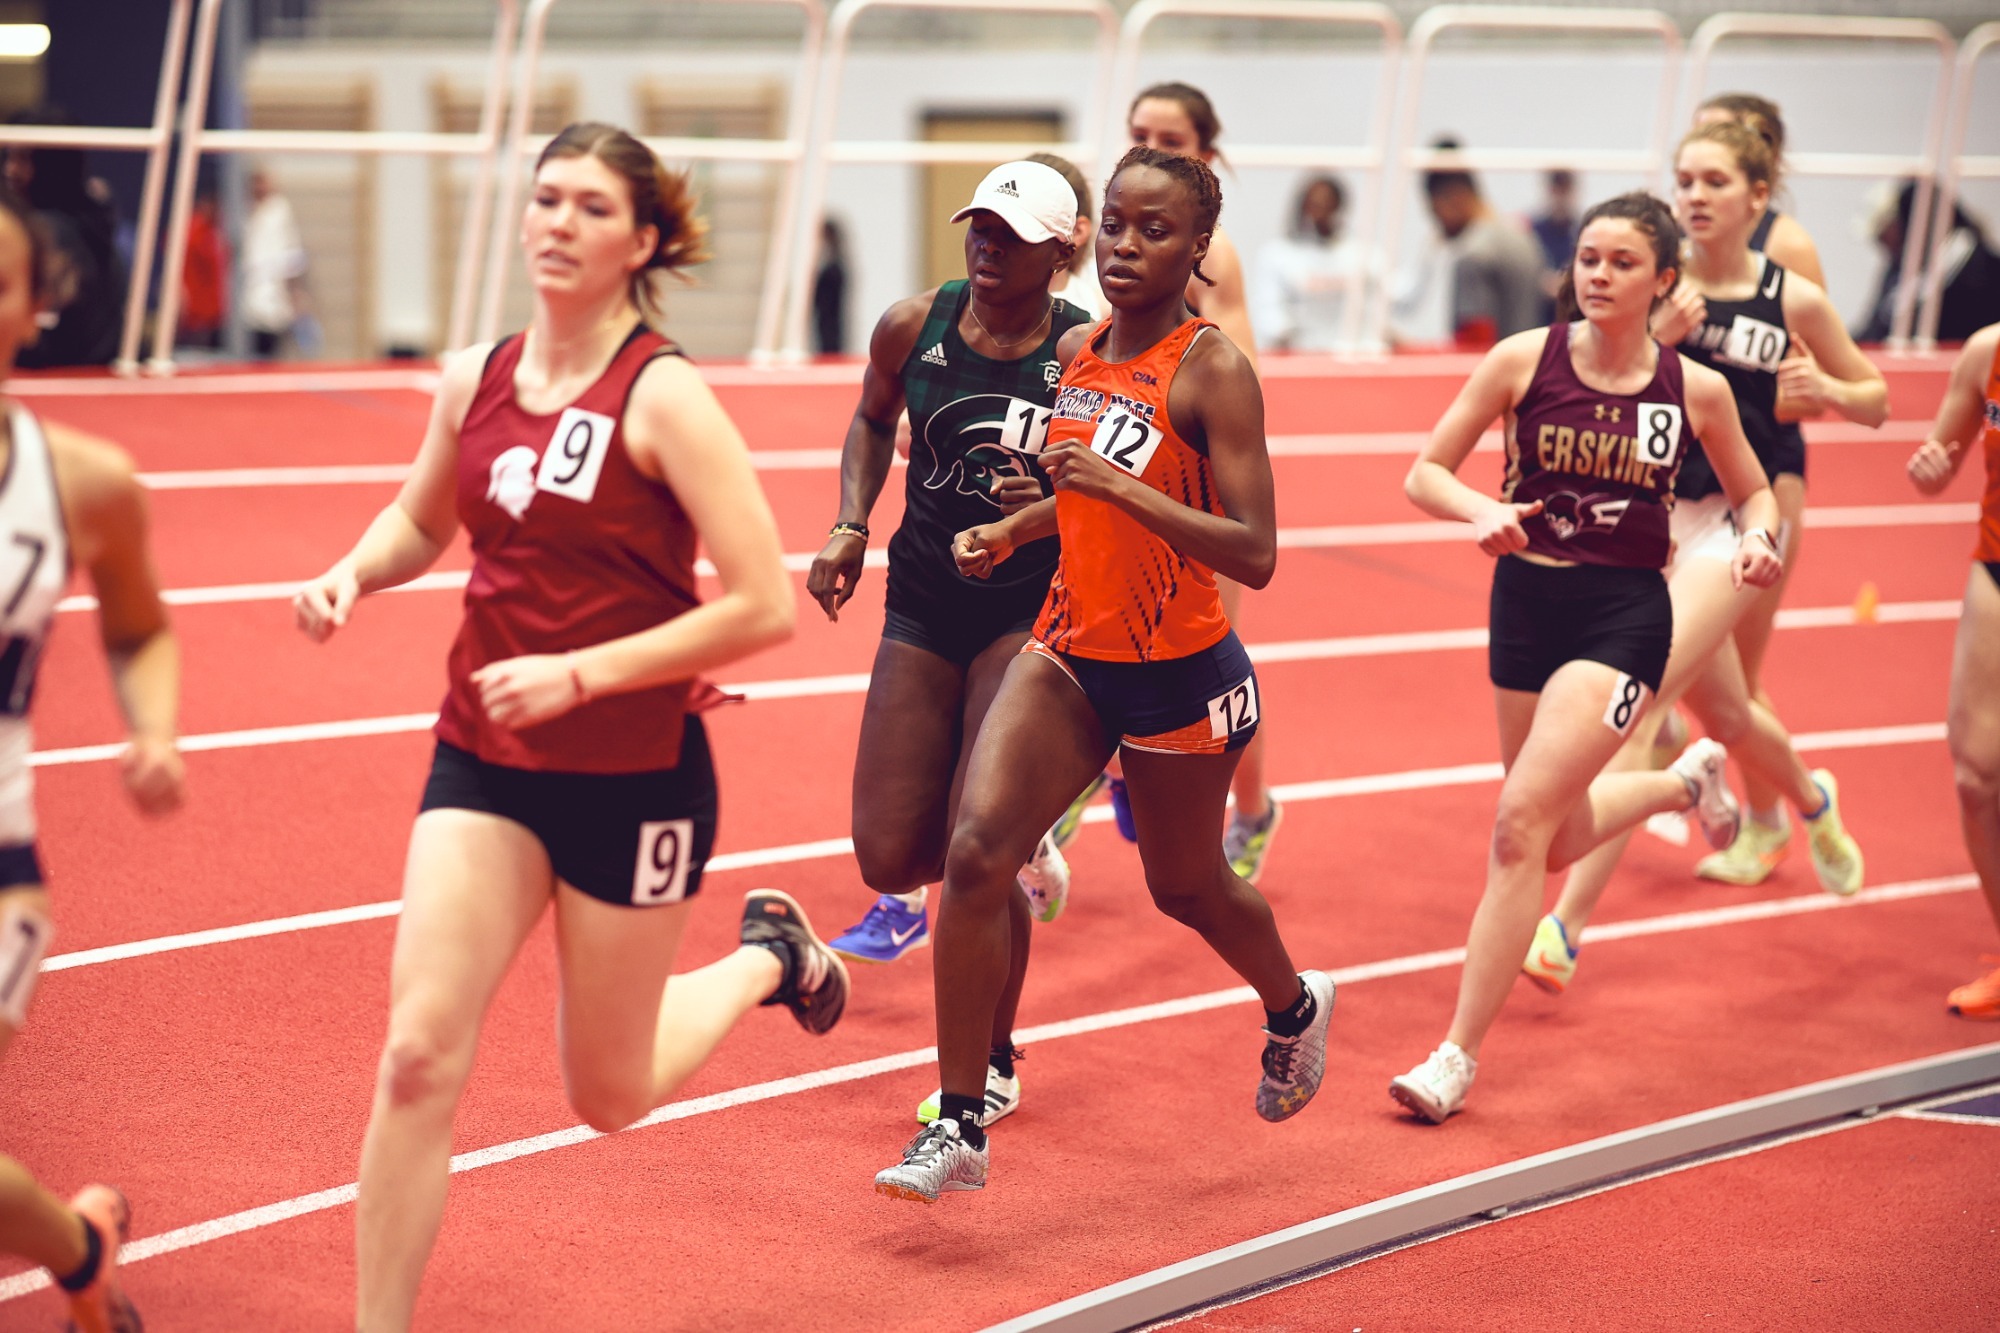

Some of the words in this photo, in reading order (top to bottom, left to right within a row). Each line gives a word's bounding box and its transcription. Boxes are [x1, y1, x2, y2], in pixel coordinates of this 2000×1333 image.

[921, 354, 948, 366] adidas
[1743, 326, 1777, 362] 10
[553, 420, 593, 485] 9
[1102, 413, 1150, 470] 12
[1648, 409, 1672, 460] 8
[12, 531, 45, 617] 7
[1218, 684, 1252, 735] 12
[1613, 679, 1640, 730] 8
[650, 828, 679, 897] 9
